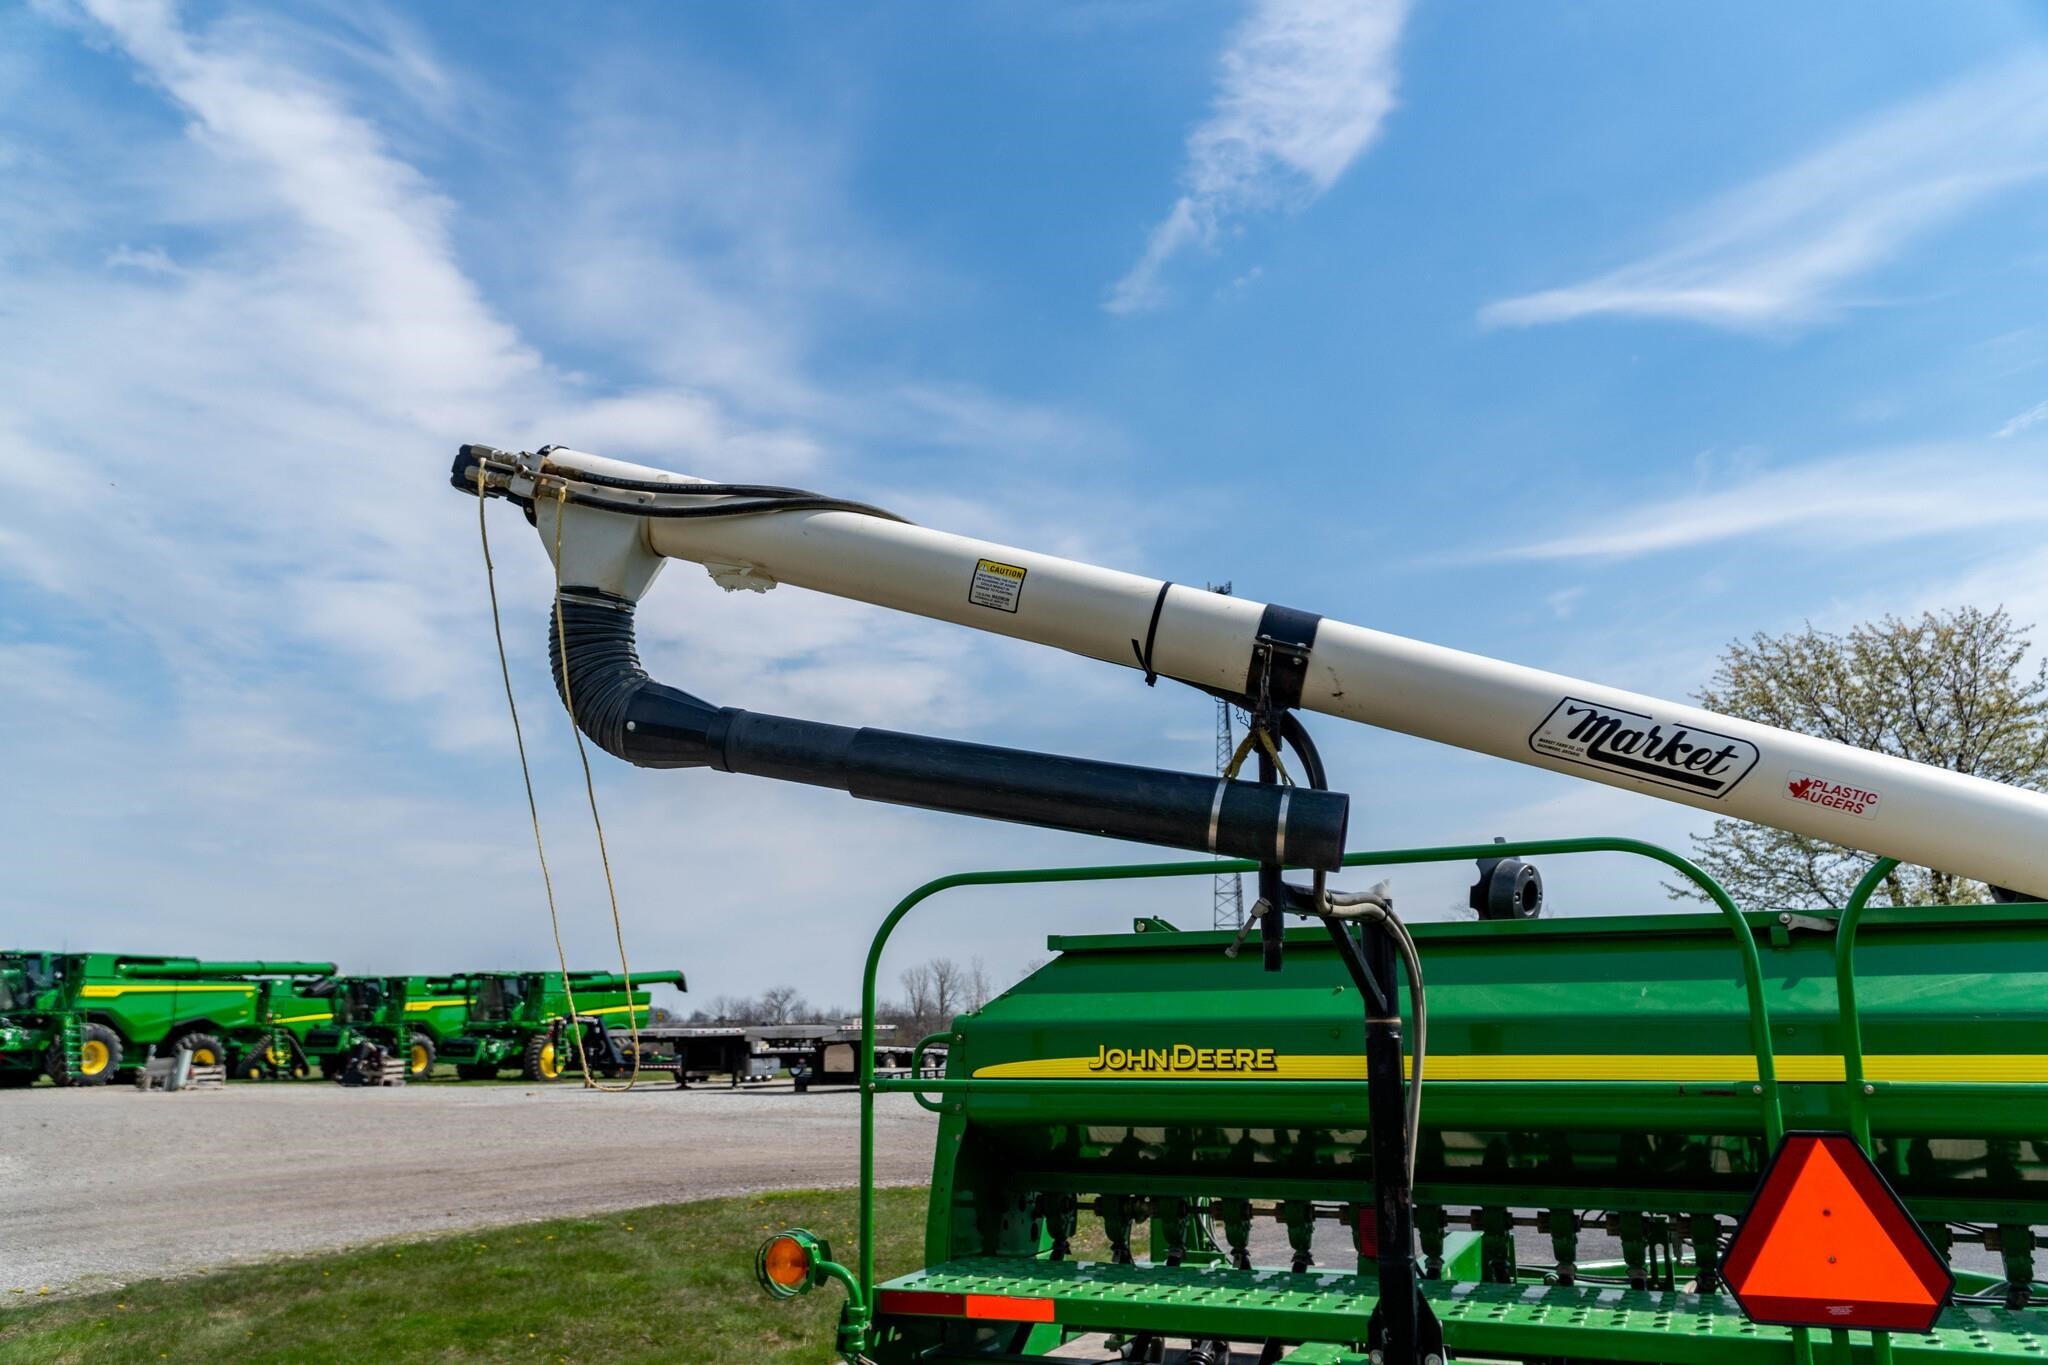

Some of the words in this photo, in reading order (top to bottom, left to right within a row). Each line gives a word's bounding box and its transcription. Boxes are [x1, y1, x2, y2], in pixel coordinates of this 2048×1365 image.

[990, 565, 1022, 578] CAUTION
[1799, 790, 1865, 814] AUGERS
[1811, 779, 1878, 805] PLASTIC
[1089, 1044, 1169, 1072] JOHN
[1172, 1044, 1278, 1072] DEERE
